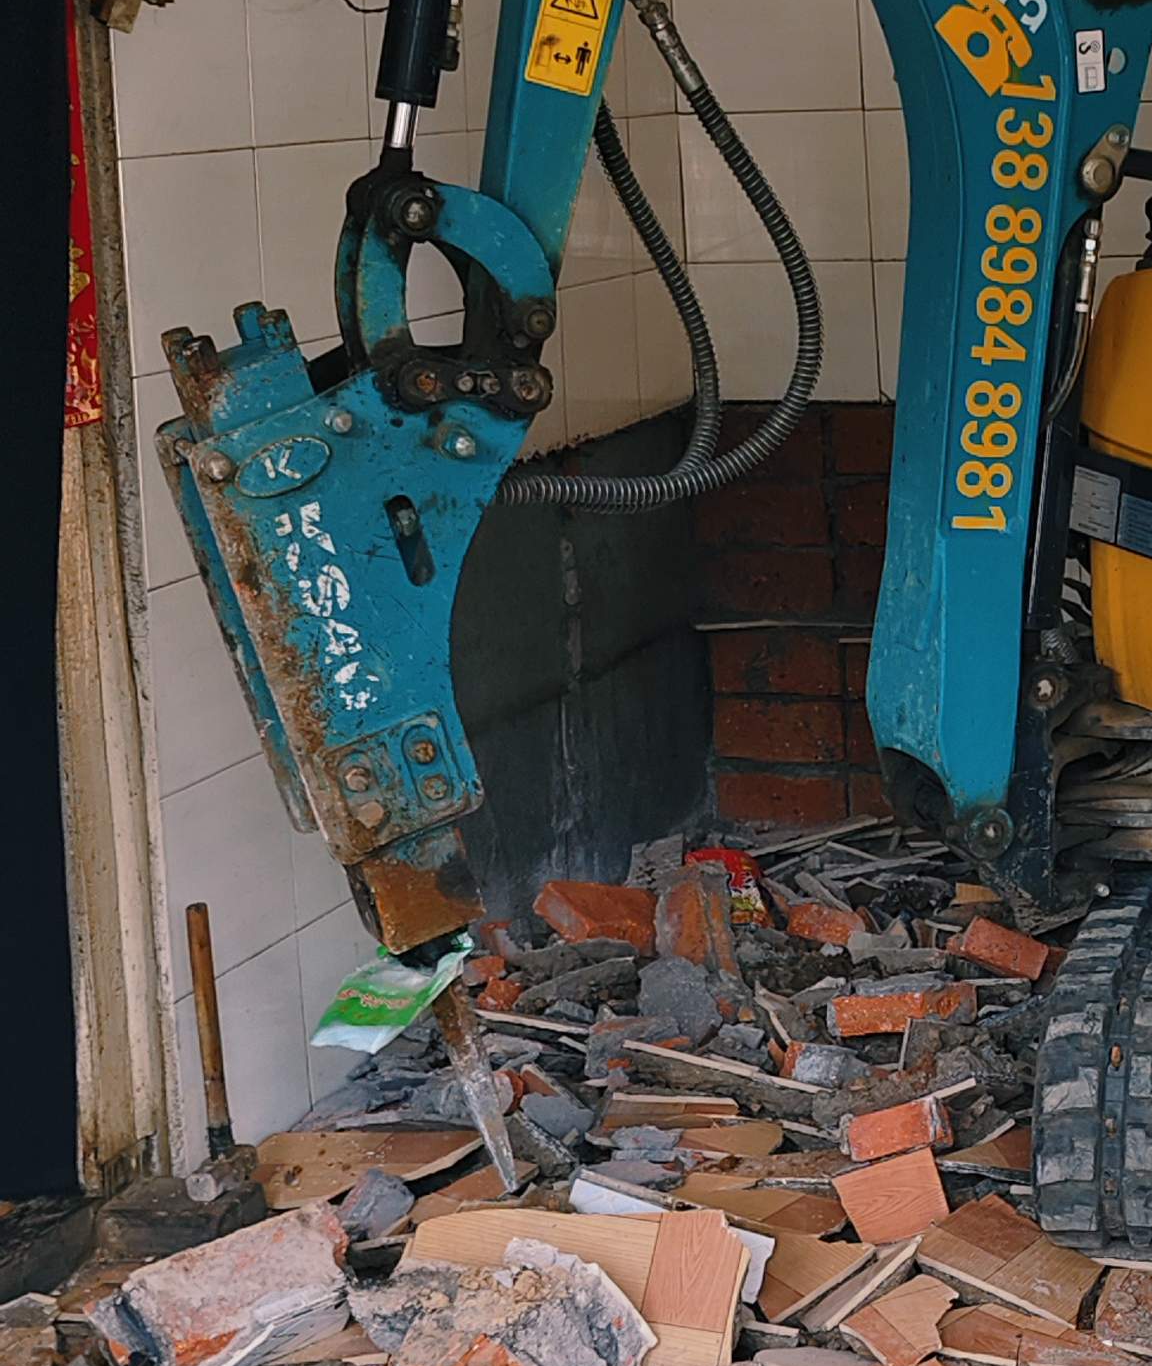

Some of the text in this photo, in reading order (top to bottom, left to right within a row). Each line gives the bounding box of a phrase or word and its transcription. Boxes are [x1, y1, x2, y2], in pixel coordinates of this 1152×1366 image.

[951, 75, 1056, 531] 138 8984 8981
